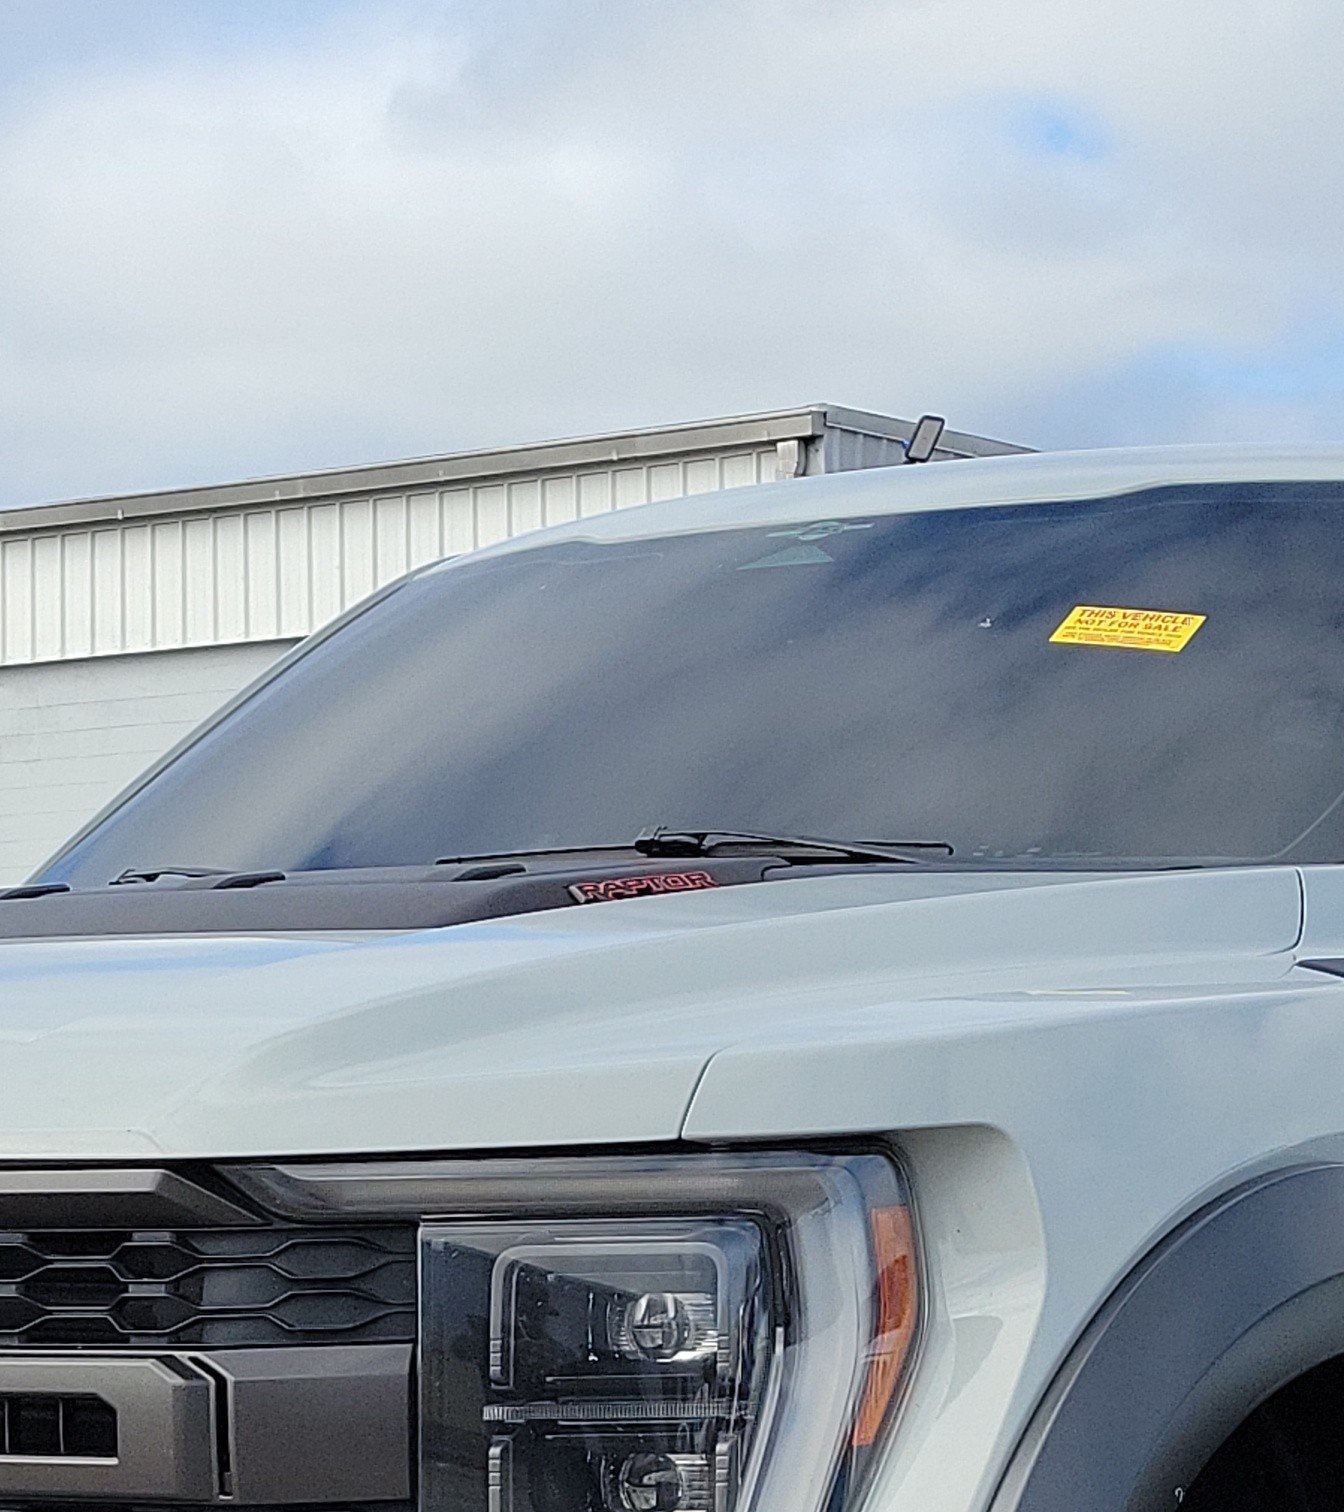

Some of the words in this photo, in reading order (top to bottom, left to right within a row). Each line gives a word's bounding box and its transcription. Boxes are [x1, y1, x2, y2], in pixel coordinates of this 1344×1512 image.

[1074, 618, 1106, 627] NOT
[1108, 620, 1140, 629] FOR
[1143, 623, 1182, 633] SALE
[1079, 609, 1117, 619] THIS
[1122, 611, 1194, 626] VEHICLE
[568, 870, 718, 903] RAPTOR
